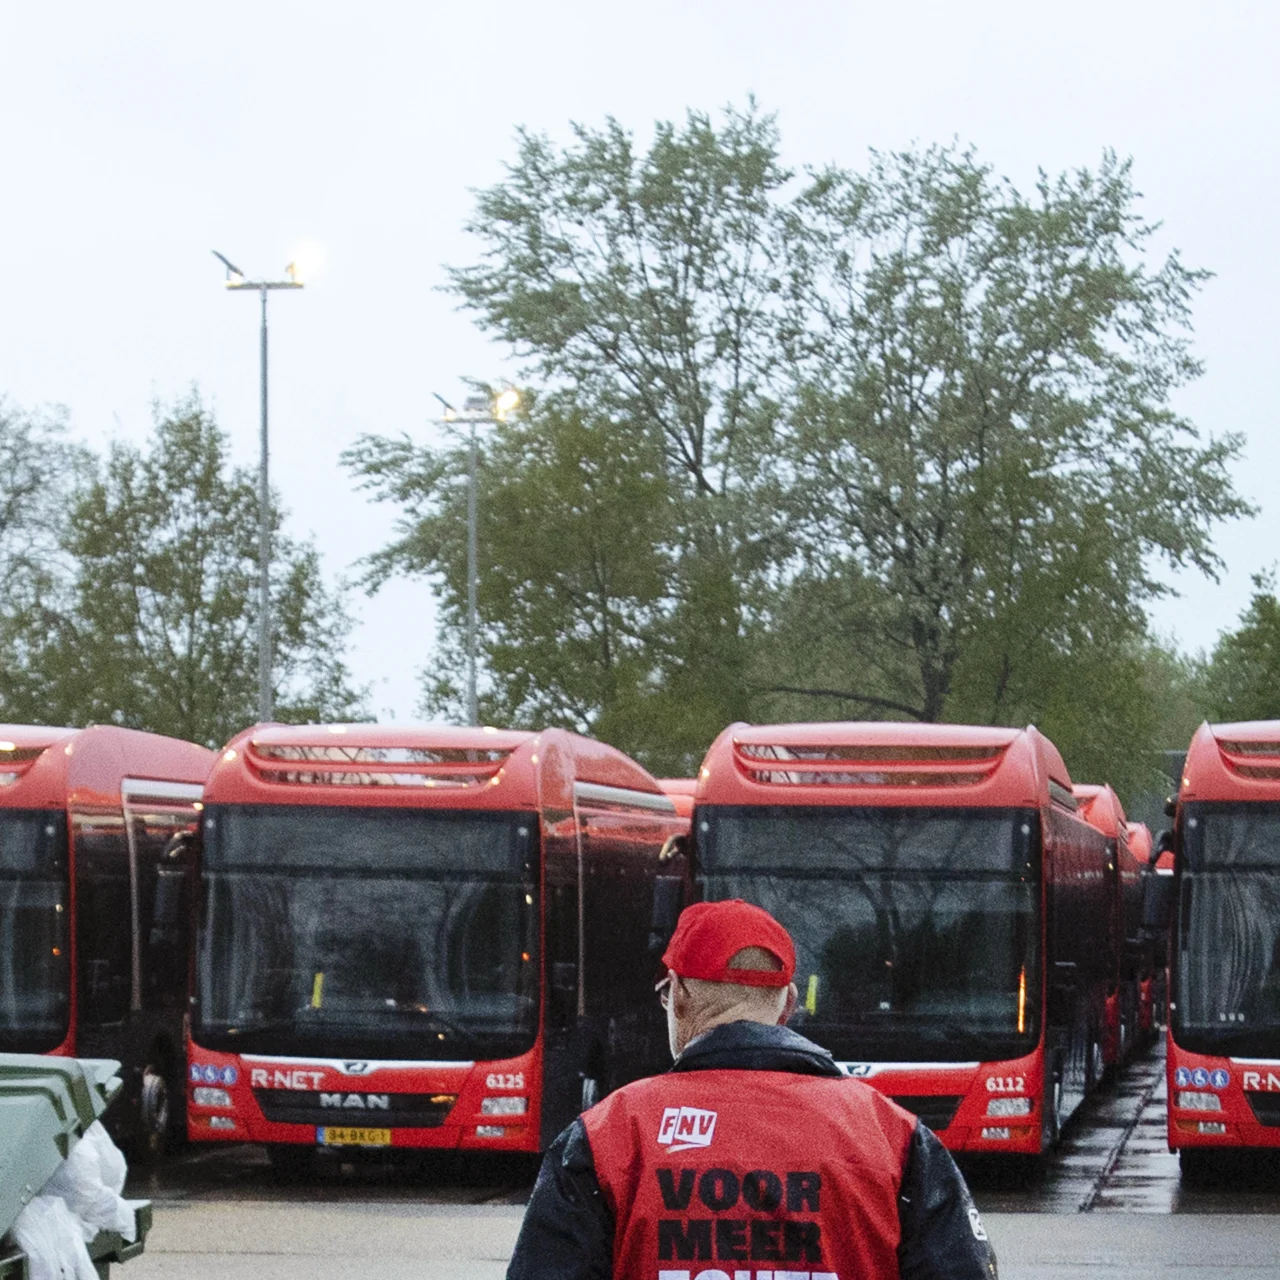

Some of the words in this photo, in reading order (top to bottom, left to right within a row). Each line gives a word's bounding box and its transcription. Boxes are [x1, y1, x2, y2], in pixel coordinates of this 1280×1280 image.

[485, 1073, 525, 1089] 6125
[985, 1077, 1025, 1093] 6112
[320, 1093, 390, 1110] MAN
[661, 1114, 716, 1137] FNV
[656, 1167, 821, 1212] VOOR
[657, 1219, 821, 1262] MEER
